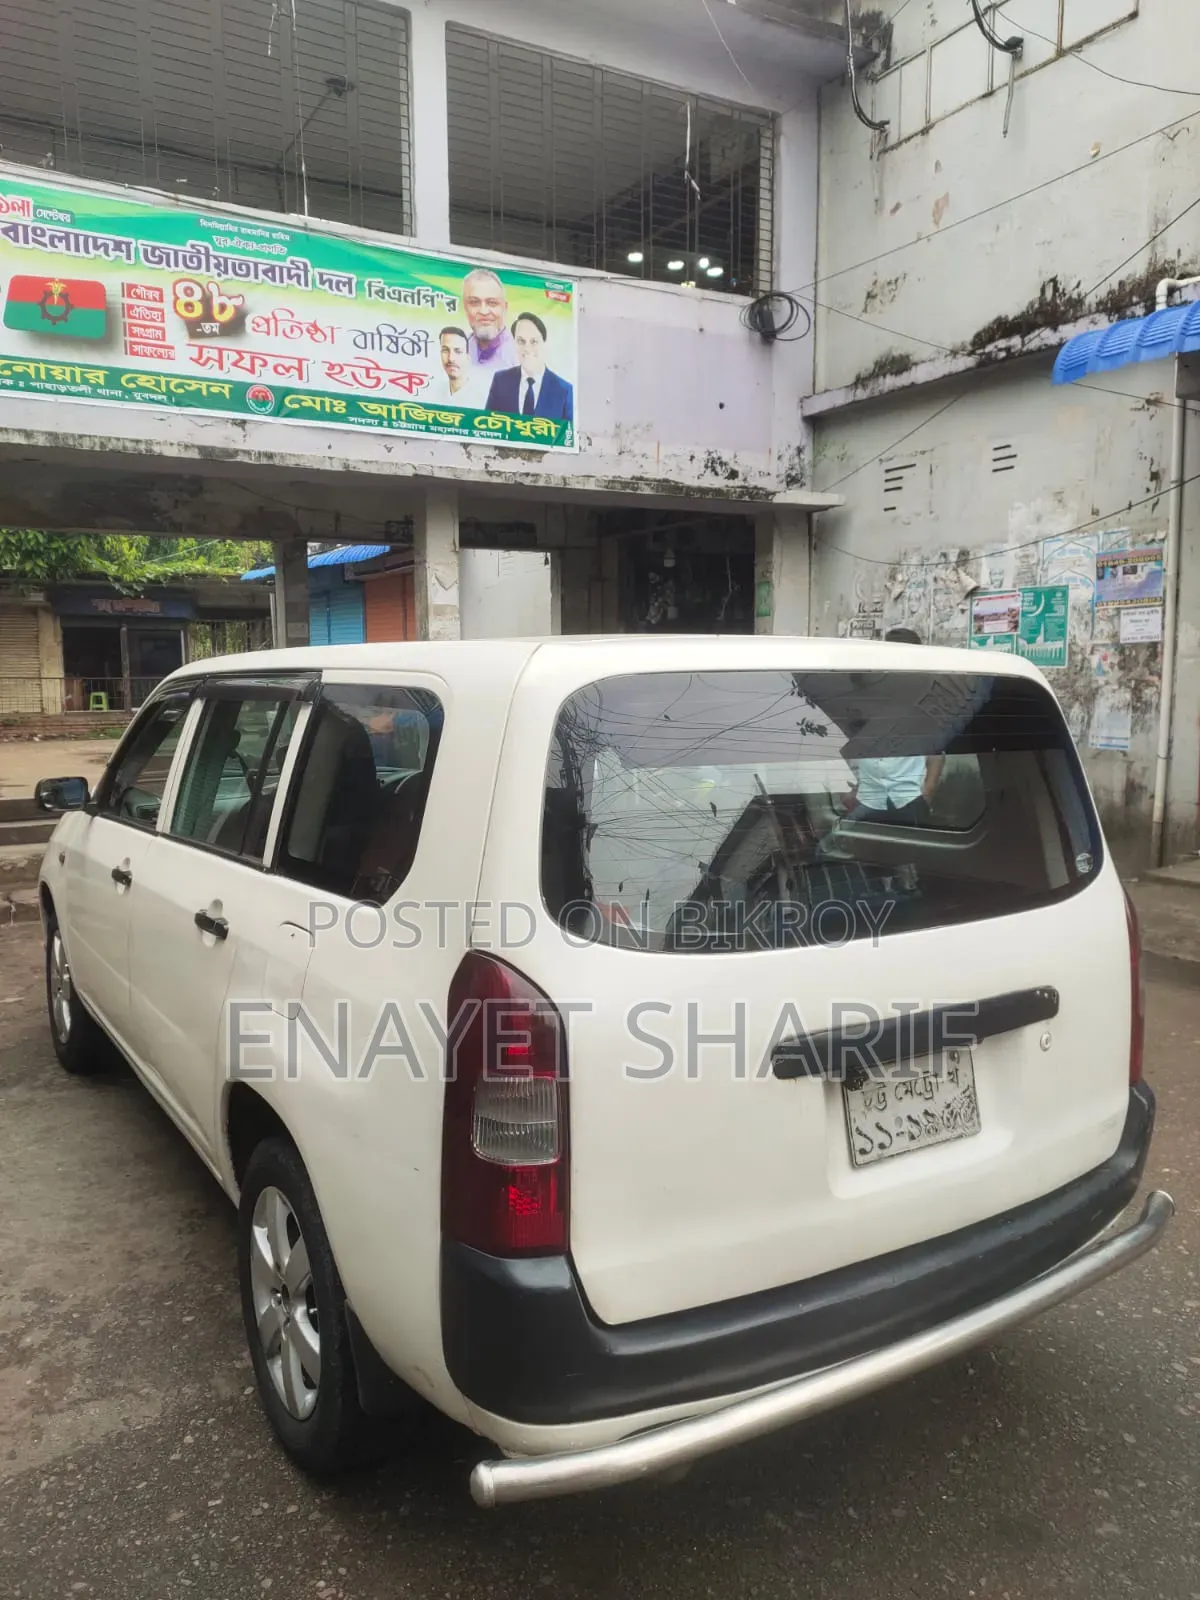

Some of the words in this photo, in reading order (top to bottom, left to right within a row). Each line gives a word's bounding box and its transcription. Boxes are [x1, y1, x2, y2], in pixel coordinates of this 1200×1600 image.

[0, 220, 134, 262] বাংলাদেশ
[142, 240, 309, 290] জাতীয়তাবাদী
[317, 271, 355, 296] দল
[130, 285, 161, 301] গৌরব
[173, 278, 245, 322] ৪৮
[131, 325, 163, 340] সংগ্রাম
[250, 308, 342, 345] প্রতিষ্ঠা
[350, 323, 434, 358] বার্ষিকী
[120, 373, 233, 399] হোসেন
[186, 342, 309, 381] সফল
[321, 356, 429, 395] হউক
[358, 400, 465, 427] আজিজ
[473, 410, 560, 438] চৌধুরী
